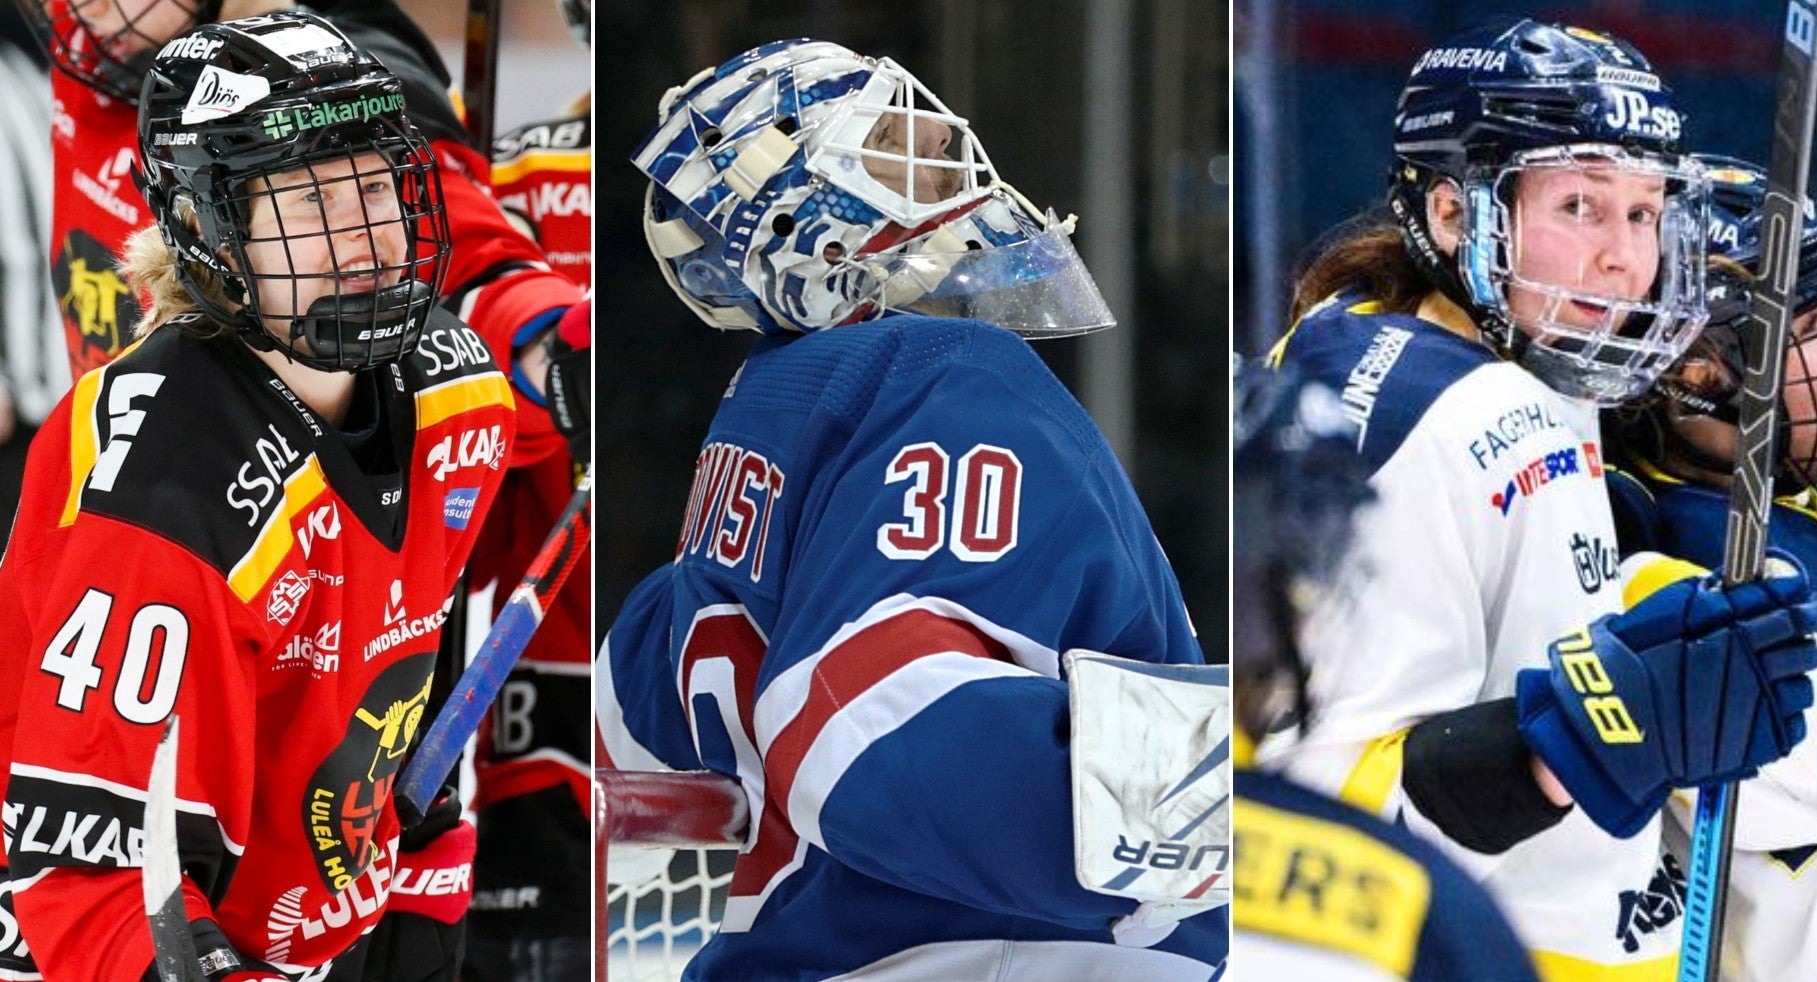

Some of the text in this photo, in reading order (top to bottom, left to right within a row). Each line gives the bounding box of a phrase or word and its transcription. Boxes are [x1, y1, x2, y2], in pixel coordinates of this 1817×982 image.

[153, 132, 198, 146] BAUER
[1606, 89, 1681, 140] JP.se
[357, 317, 416, 342] BAUER
[269, 378, 323, 438] BAUER
[876, 441, 1023, 563] 30
[40, 587, 190, 725] 40
[311, 788, 342, 851] LULEÅ
